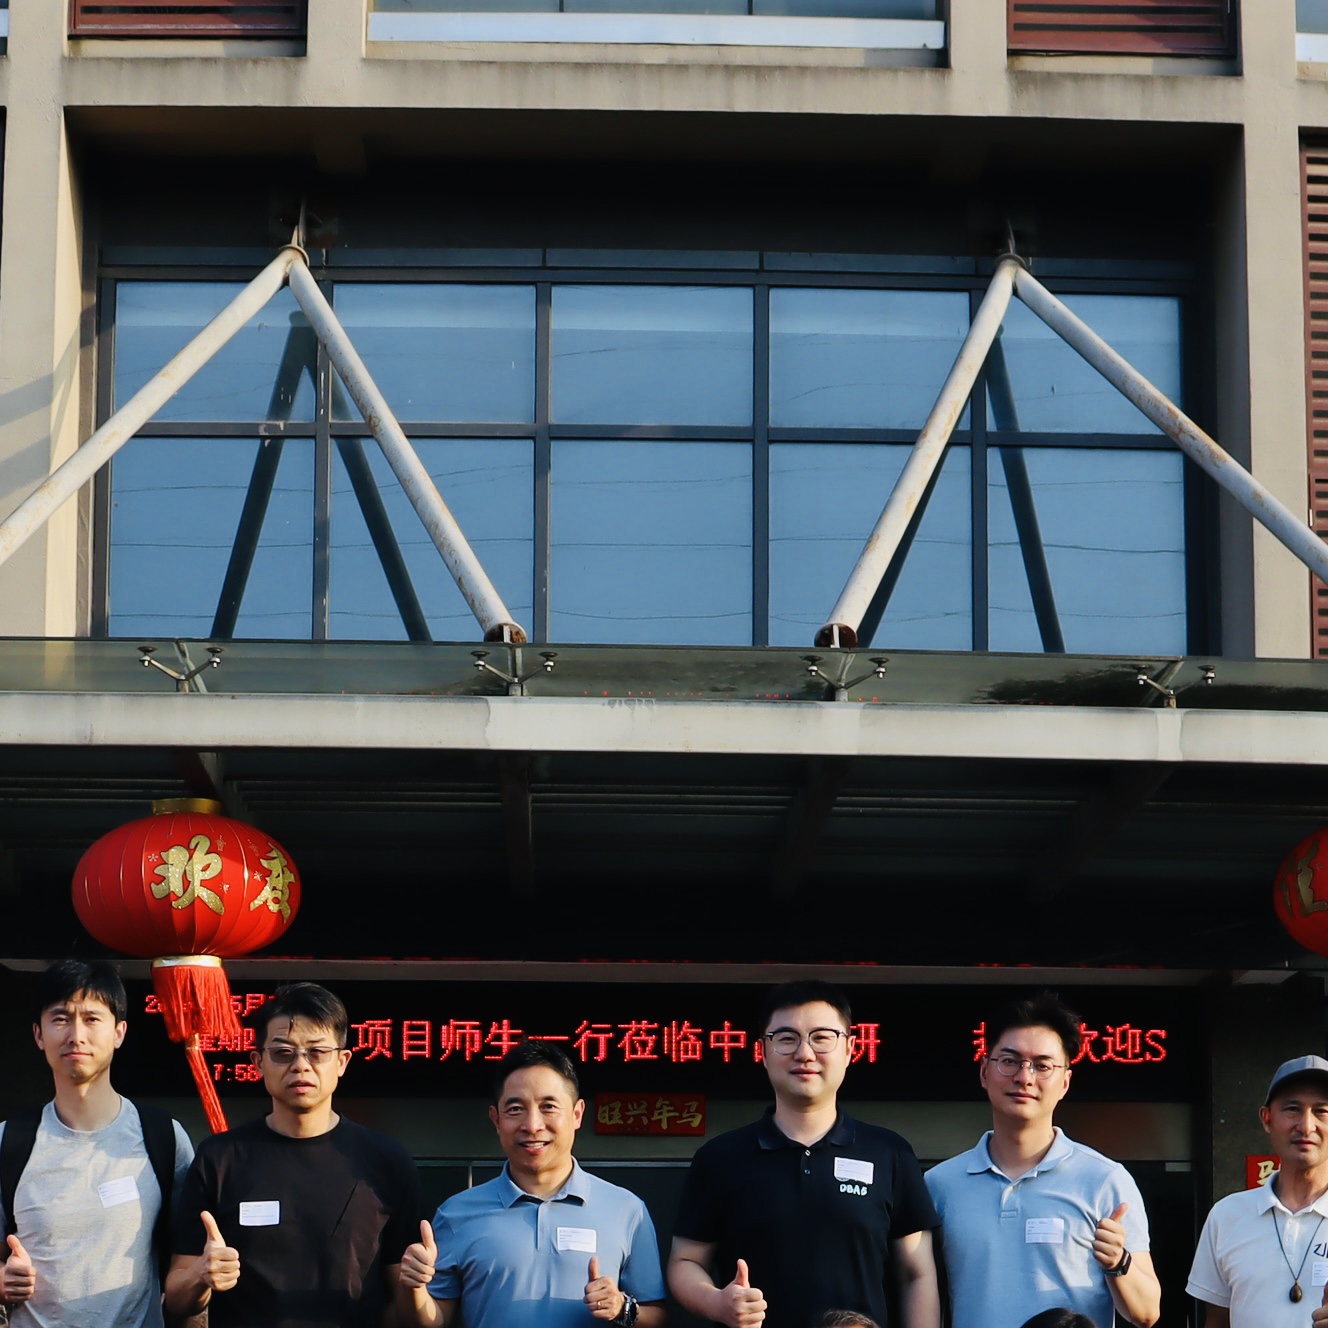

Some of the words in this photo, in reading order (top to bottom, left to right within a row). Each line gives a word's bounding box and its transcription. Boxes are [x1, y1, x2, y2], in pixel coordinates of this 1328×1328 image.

[351, 1018, 881, 1062] 项目师生一行莅临中研
